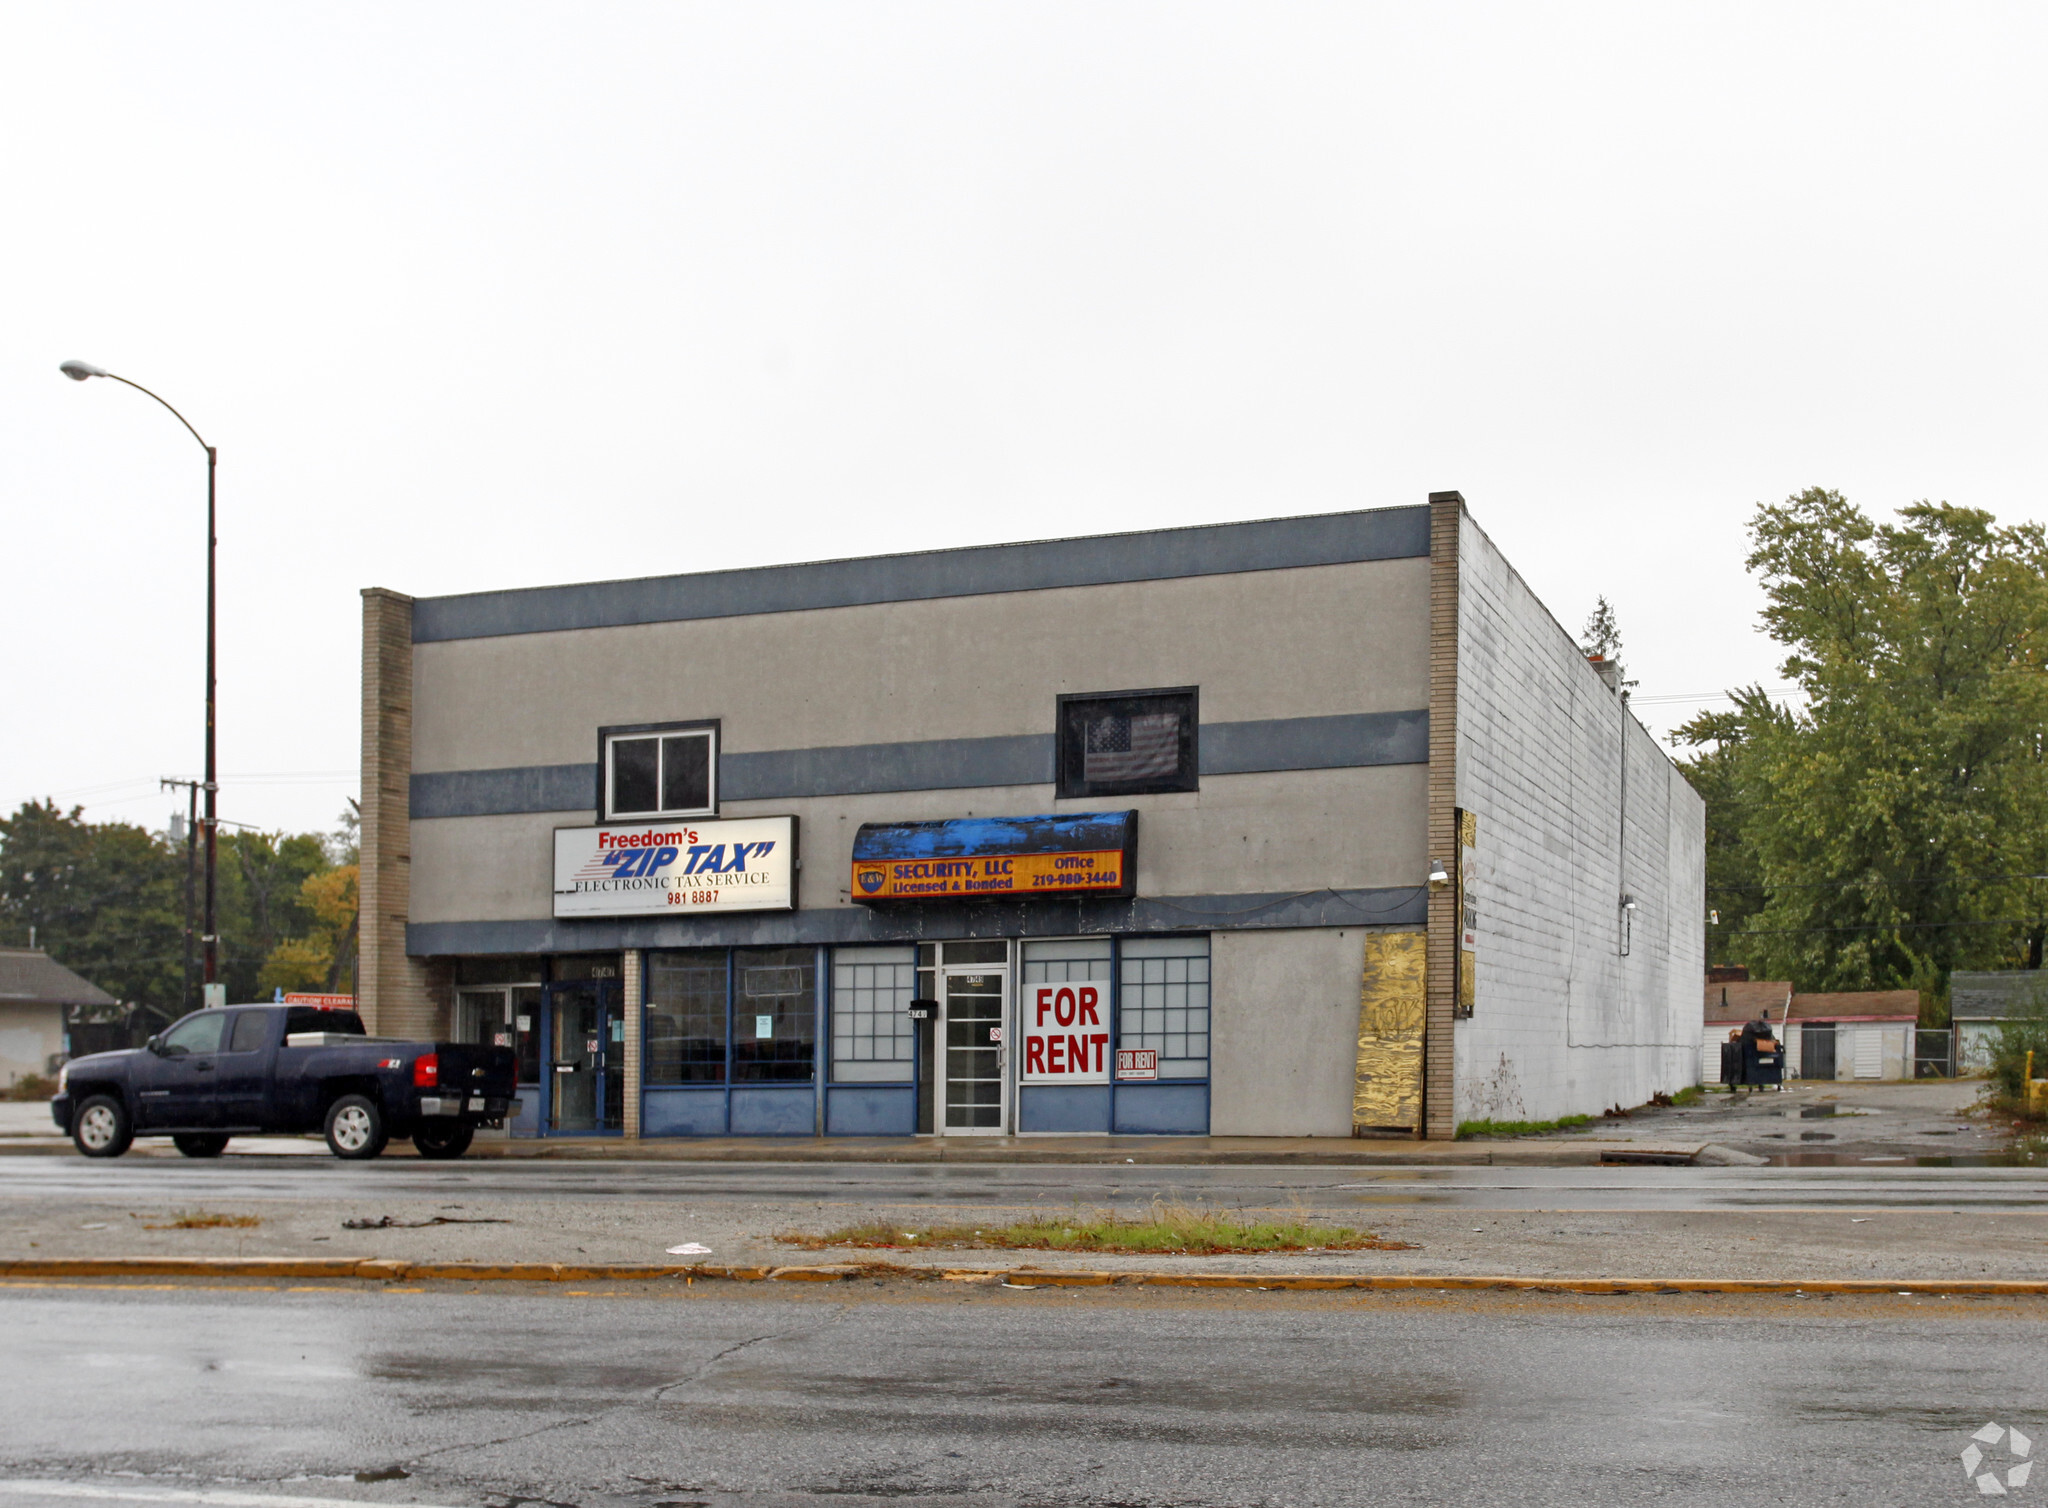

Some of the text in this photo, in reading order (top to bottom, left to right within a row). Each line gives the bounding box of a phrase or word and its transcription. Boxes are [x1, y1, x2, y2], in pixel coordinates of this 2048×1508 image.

[599, 828, 698, 850] Freedom's
[893, 860, 1014, 880] SECURITY, LLC
[1055, 856, 1095, 869] Office
[575, 872, 770, 893] ELECTRONIC TAX SERVICE
[893, 877, 1013, 893] Licensed & Bonded
[1032, 871, 1117, 886] 219-980-3440
[667, 890, 719, 905] 981 8887
[1037, 987, 1100, 1027] FOR
[1026, 1033, 1109, 1074] RENT
[1118, 1052, 1155, 1069] FOR RENT
